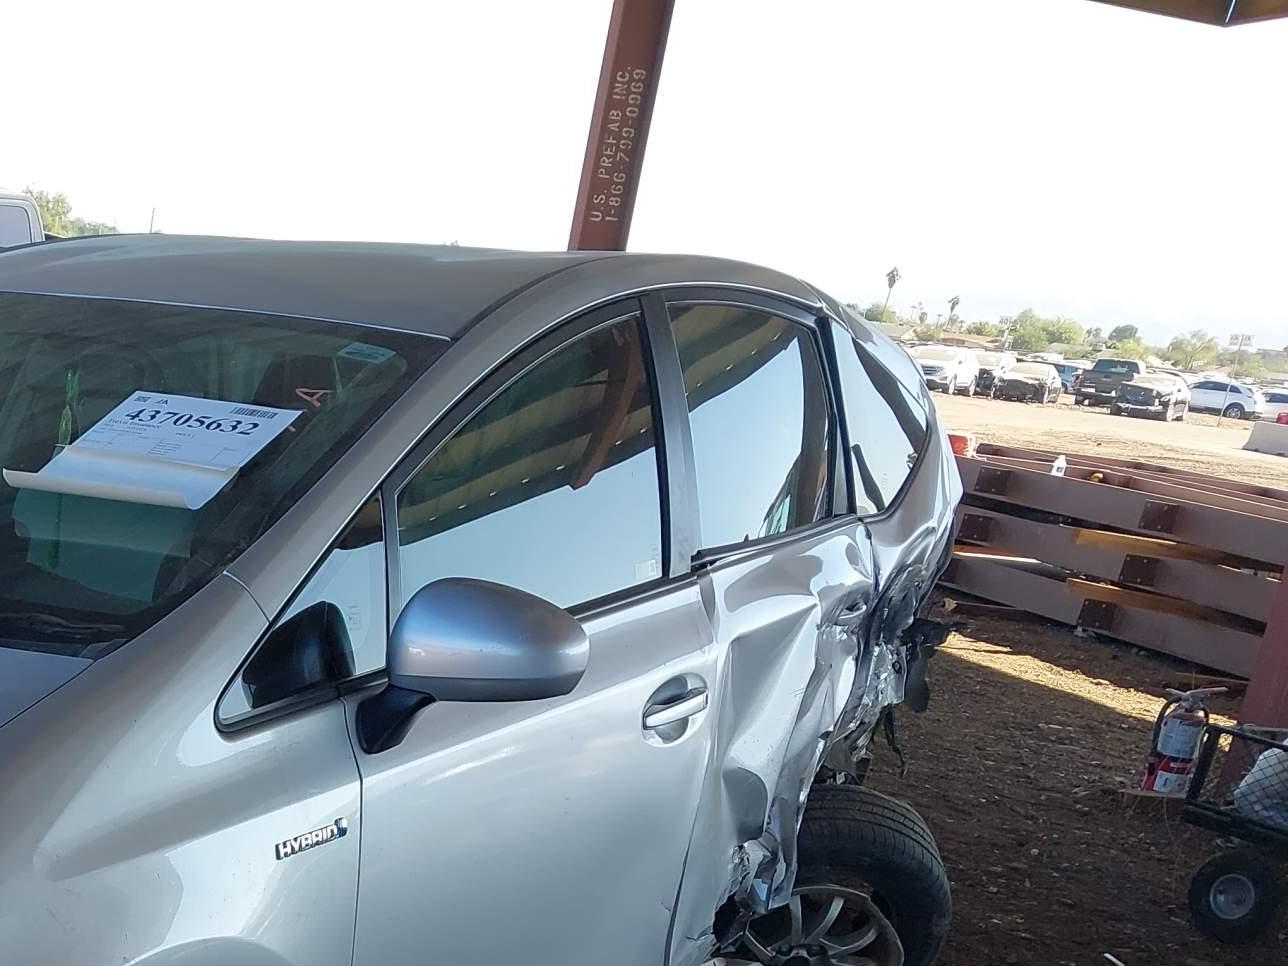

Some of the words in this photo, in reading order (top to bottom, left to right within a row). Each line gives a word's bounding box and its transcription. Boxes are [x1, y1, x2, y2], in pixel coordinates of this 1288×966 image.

[613, 66, 632, 100] INC.
[598, 110, 622, 179] PREFAB
[590, 190, 607, 222] U.S.
[125, 407, 260, 436] 43705632
[278, 824, 338, 858] HYBRID
